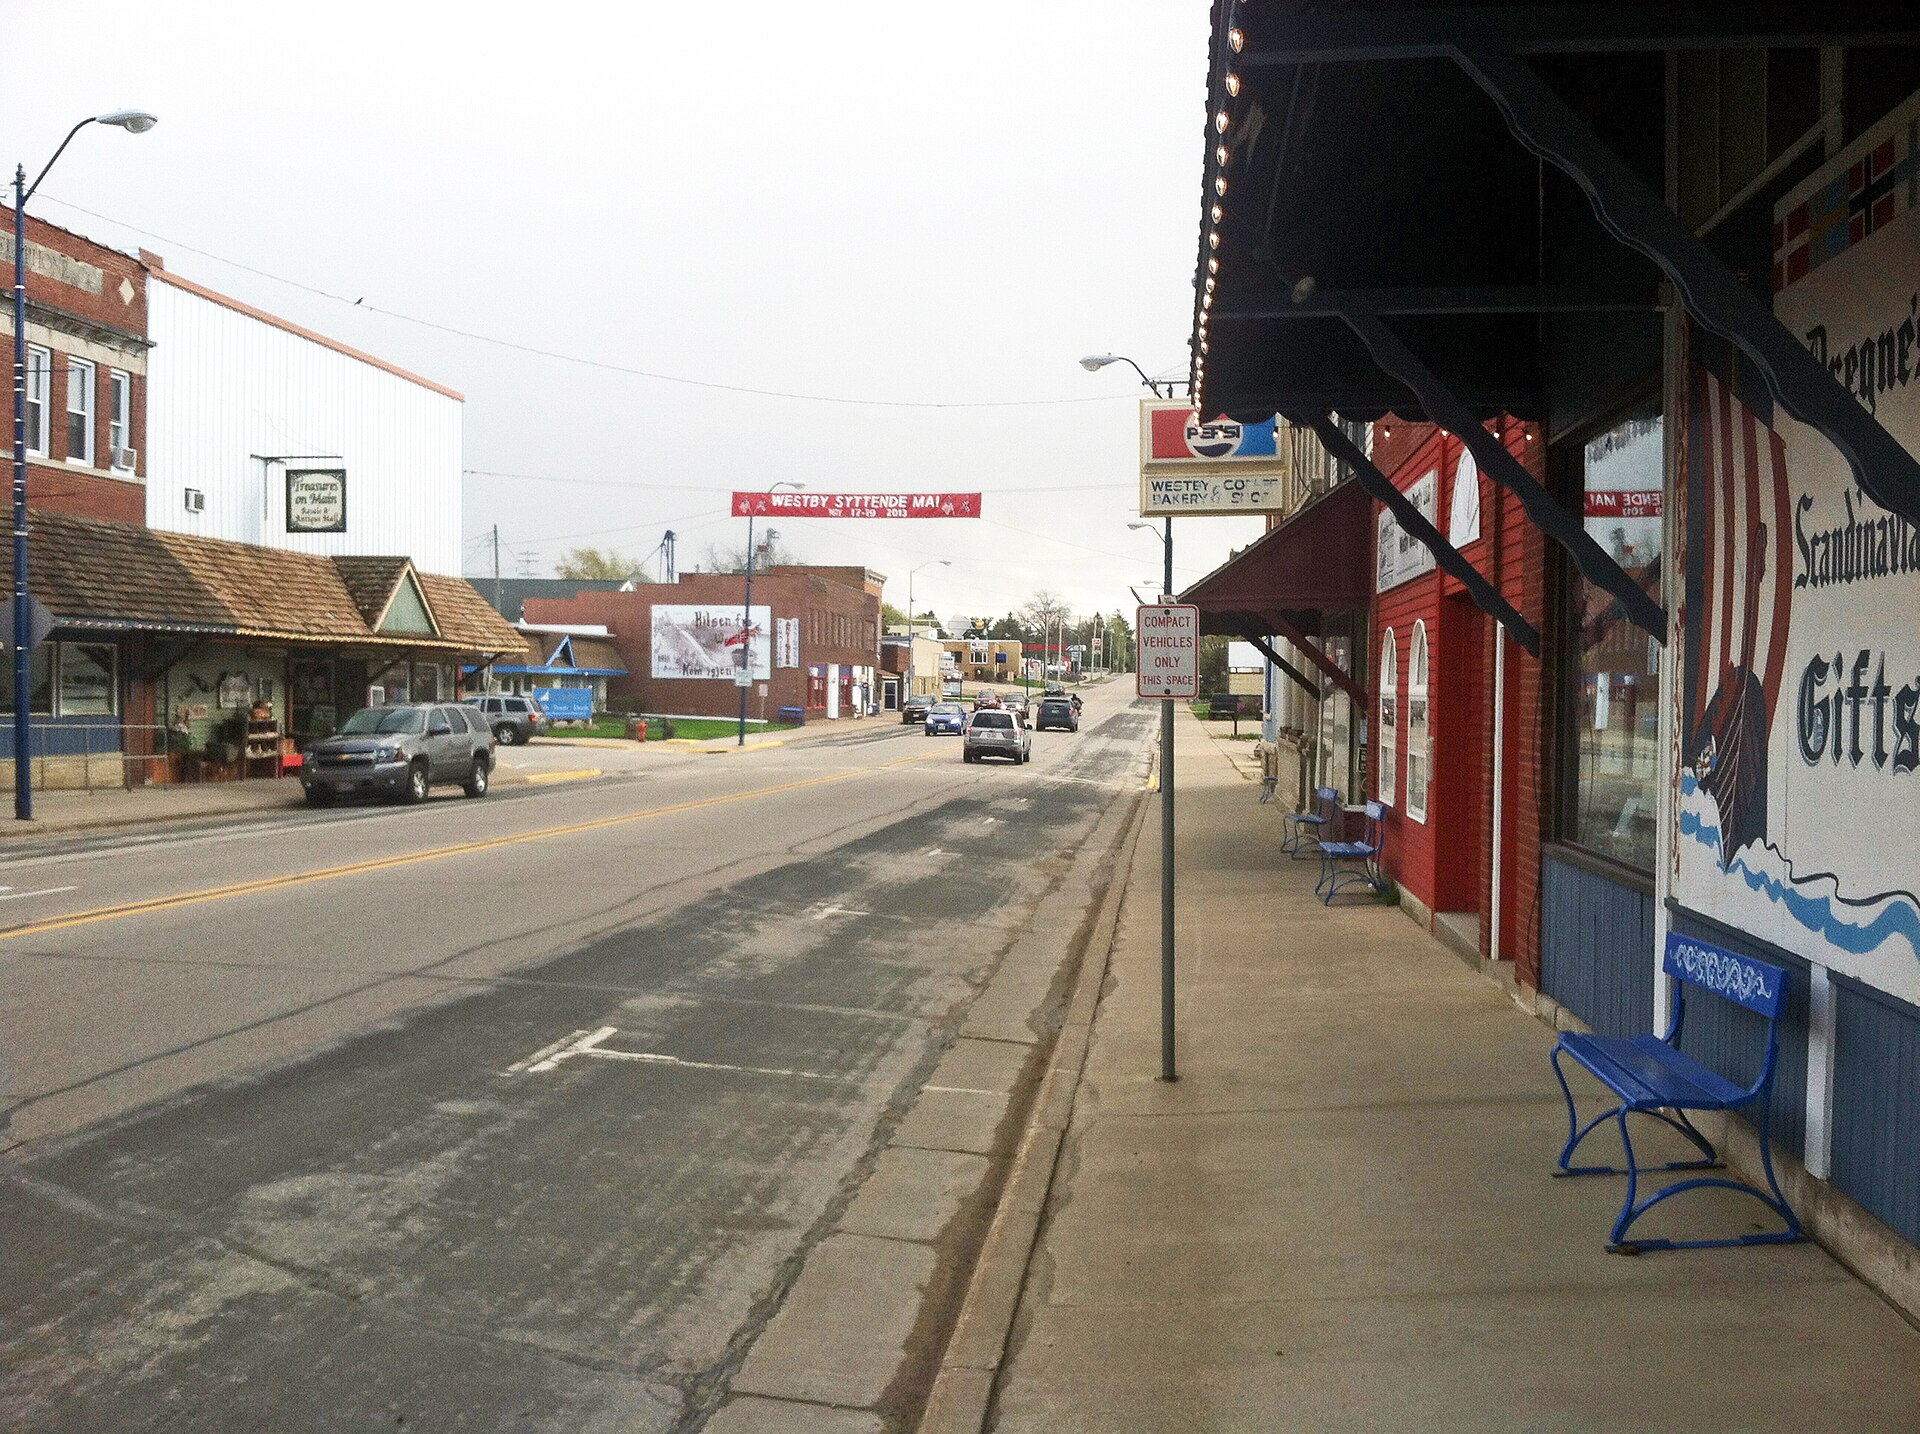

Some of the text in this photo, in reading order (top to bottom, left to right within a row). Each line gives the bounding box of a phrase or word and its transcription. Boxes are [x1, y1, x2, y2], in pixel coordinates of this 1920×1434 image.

[295, 496, 307, 504] on
[772, 494, 940, 508] WESTBY SYTTENDE MAI
[886, 508, 908, 517] 2013
[1144, 616, 1191, 628] COMPACT
[1143, 637, 1193, 648] VEHICLES
[1154, 656, 1180, 668] ONLY
[1143, 675, 1194, 686] THIS SPACE
